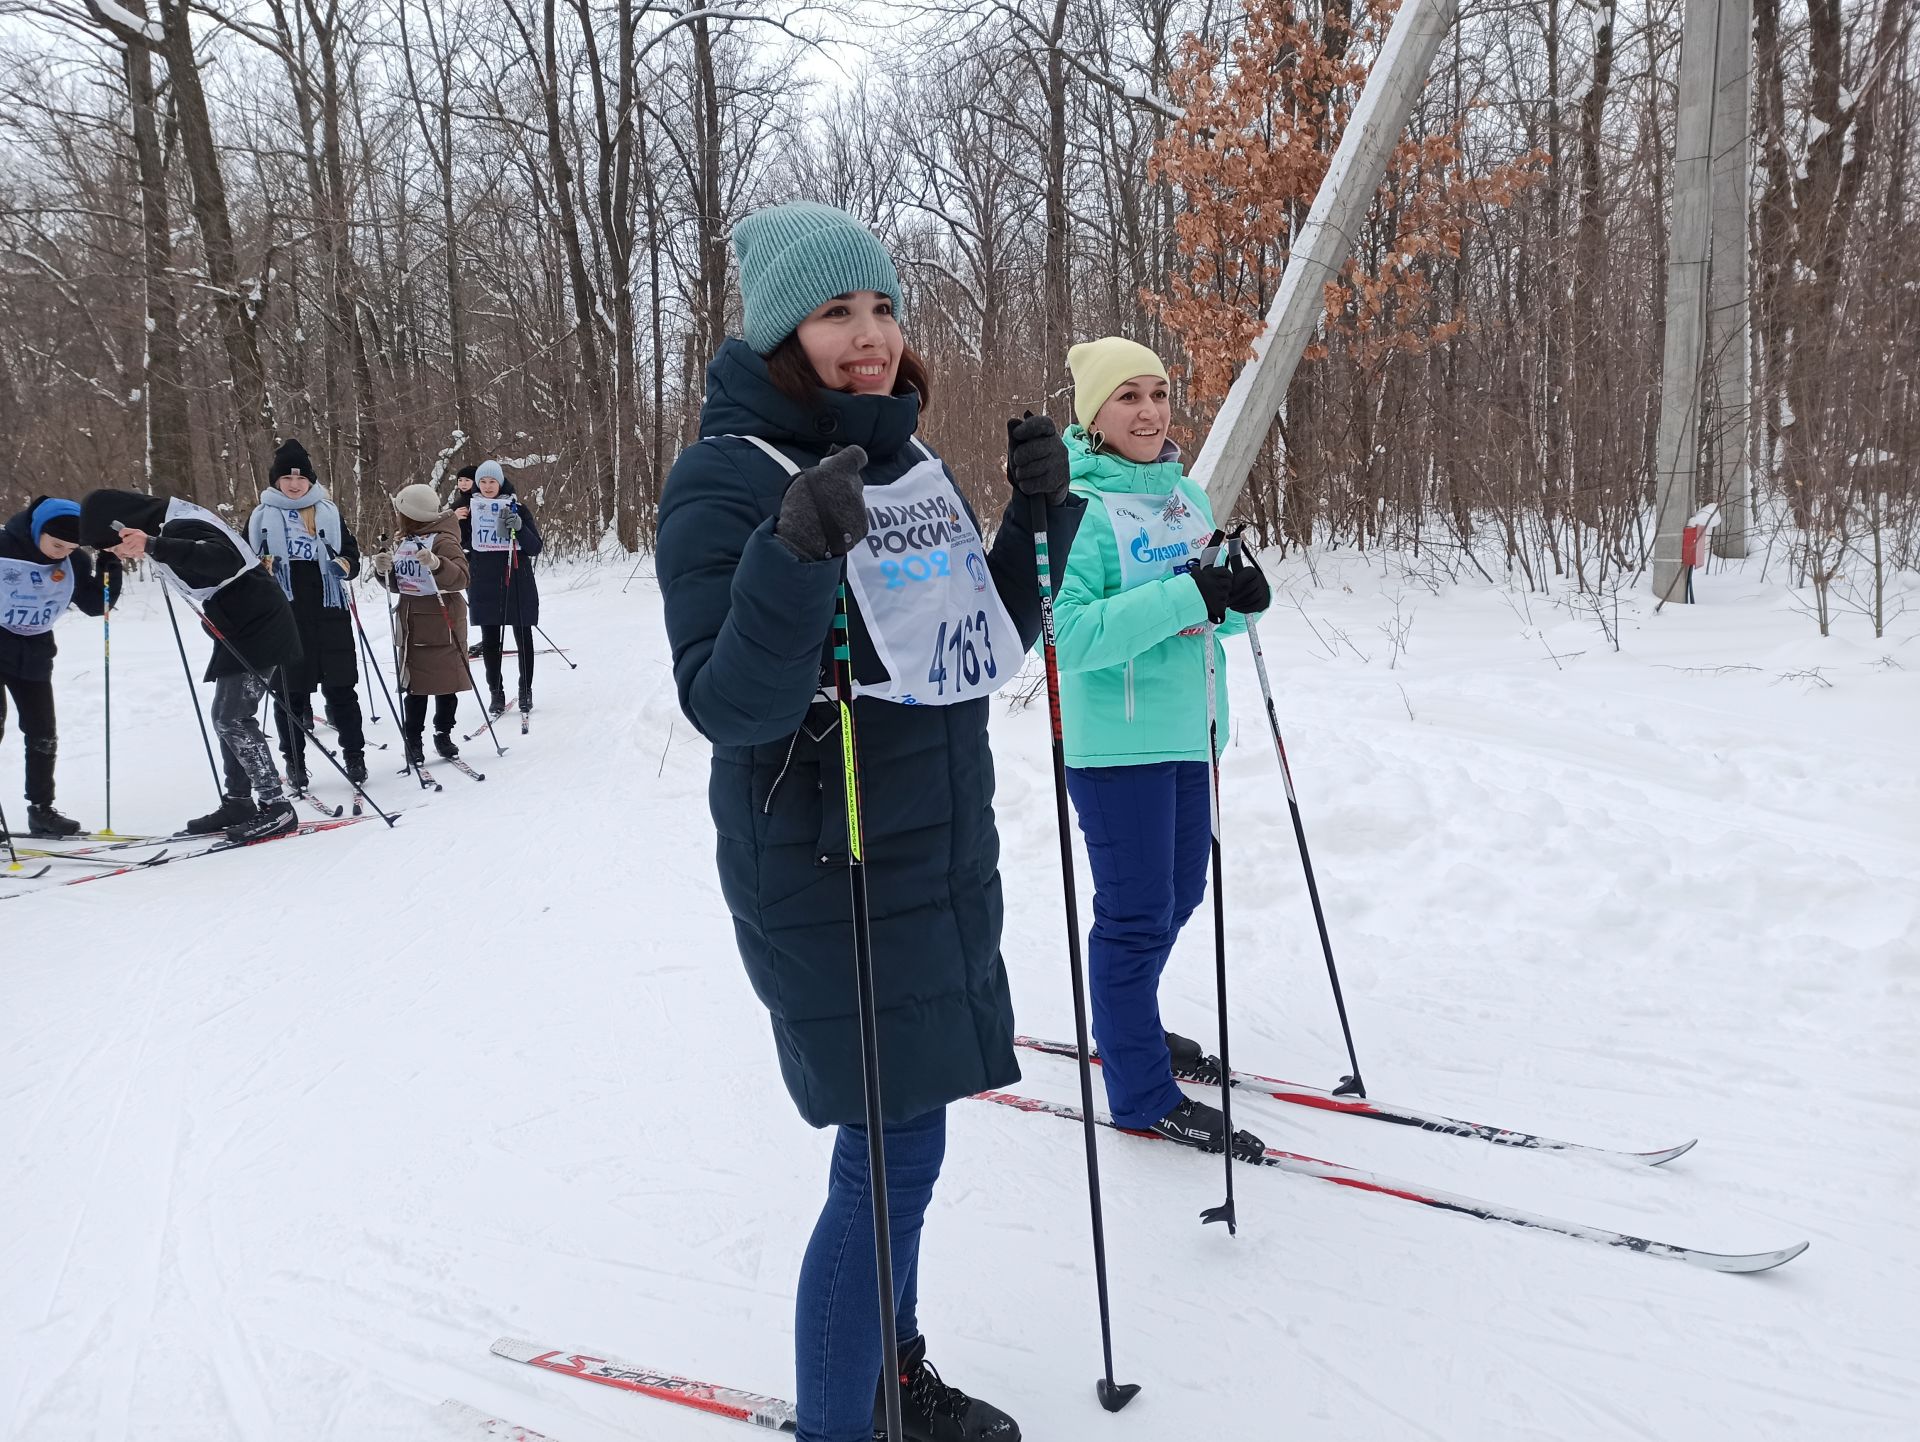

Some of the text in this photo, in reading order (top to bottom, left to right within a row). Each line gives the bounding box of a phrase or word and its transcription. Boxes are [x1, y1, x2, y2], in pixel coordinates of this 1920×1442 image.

[1153, 541, 1190, 562] ГАЗПРО
[4, 608, 52, 626] 1748
[1043, 596, 1055, 647] CLASSIC 30
[928, 610, 997, 696] 4163
